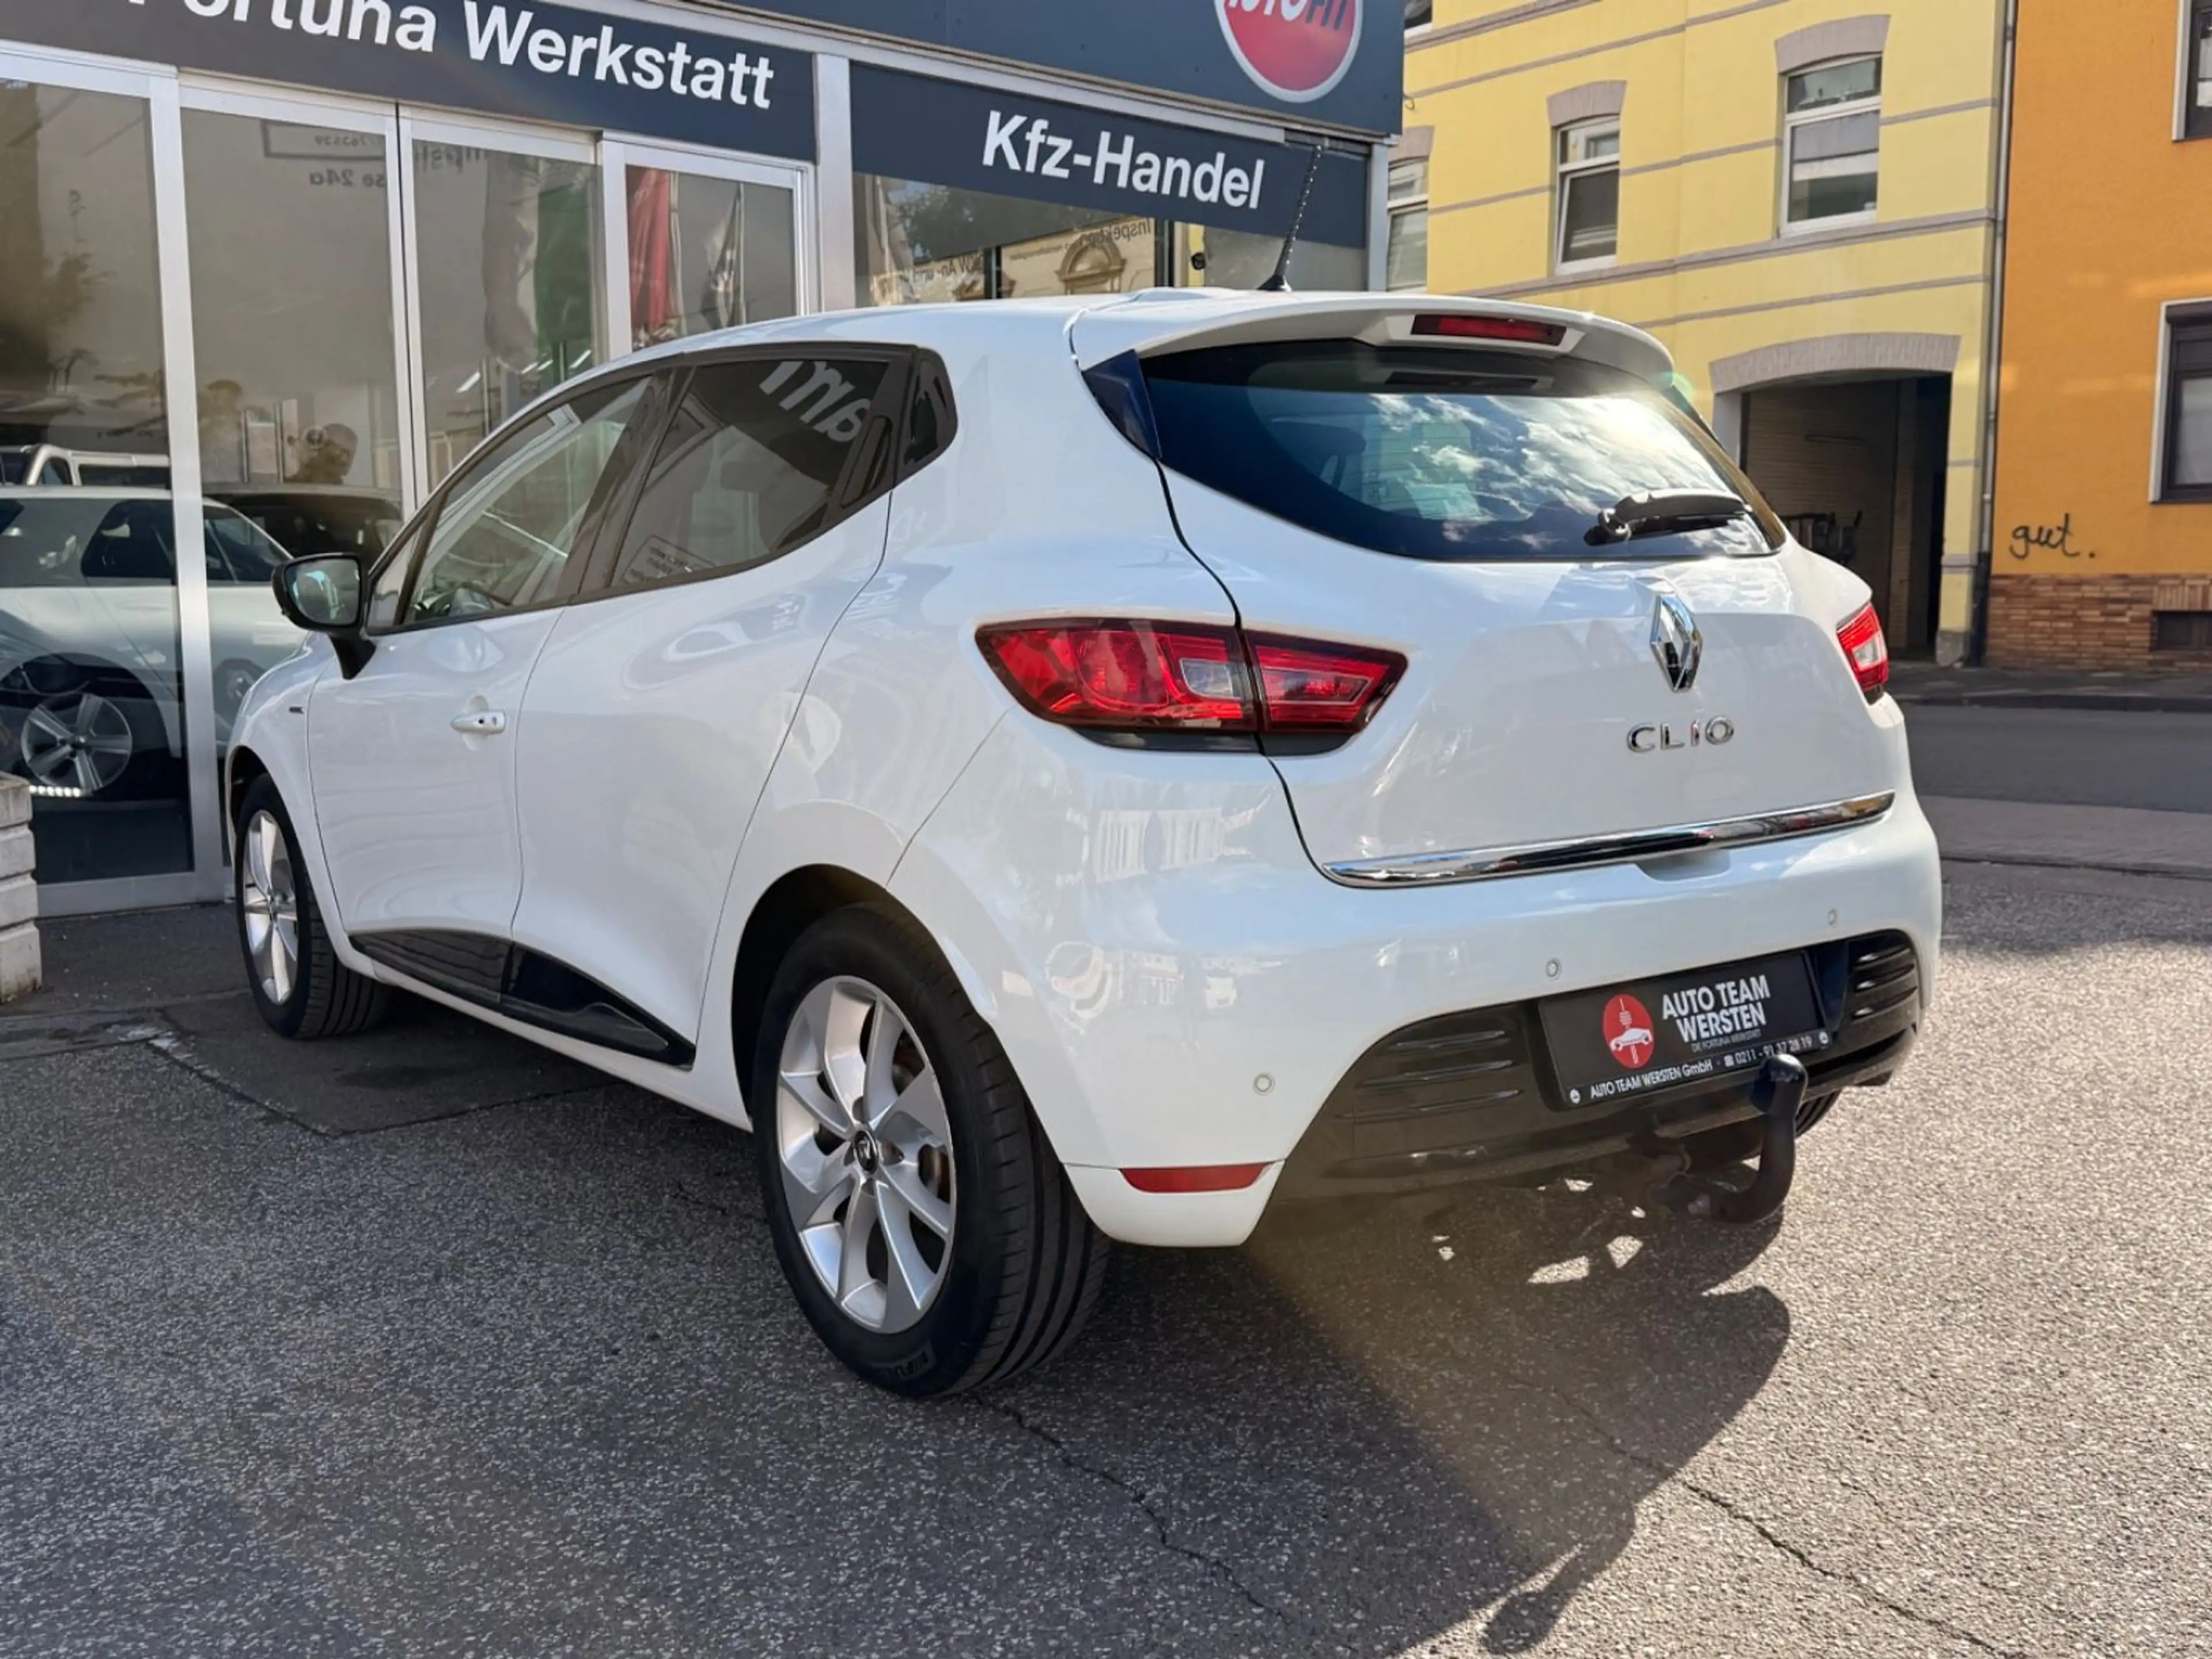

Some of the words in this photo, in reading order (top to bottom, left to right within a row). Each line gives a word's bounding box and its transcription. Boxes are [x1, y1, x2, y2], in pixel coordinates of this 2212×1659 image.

[464, 1, 774, 108] Werkstatt
[982, 111, 1265, 209] Kfz-Handel
[1627, 715, 1734, 753] CLIO
[1662, 986, 1715, 1020] AUTO
[1715, 974, 1771, 1006] TEAM
[1676, 1002, 1766, 1042] WERSTEN
[1590, 1082, 1615, 1099] AUTO
[1615, 1077, 1641, 1093] TEAM
[1642, 1067, 1681, 1085] WERSTEN
[1682, 1059, 1714, 1077] GmbH
